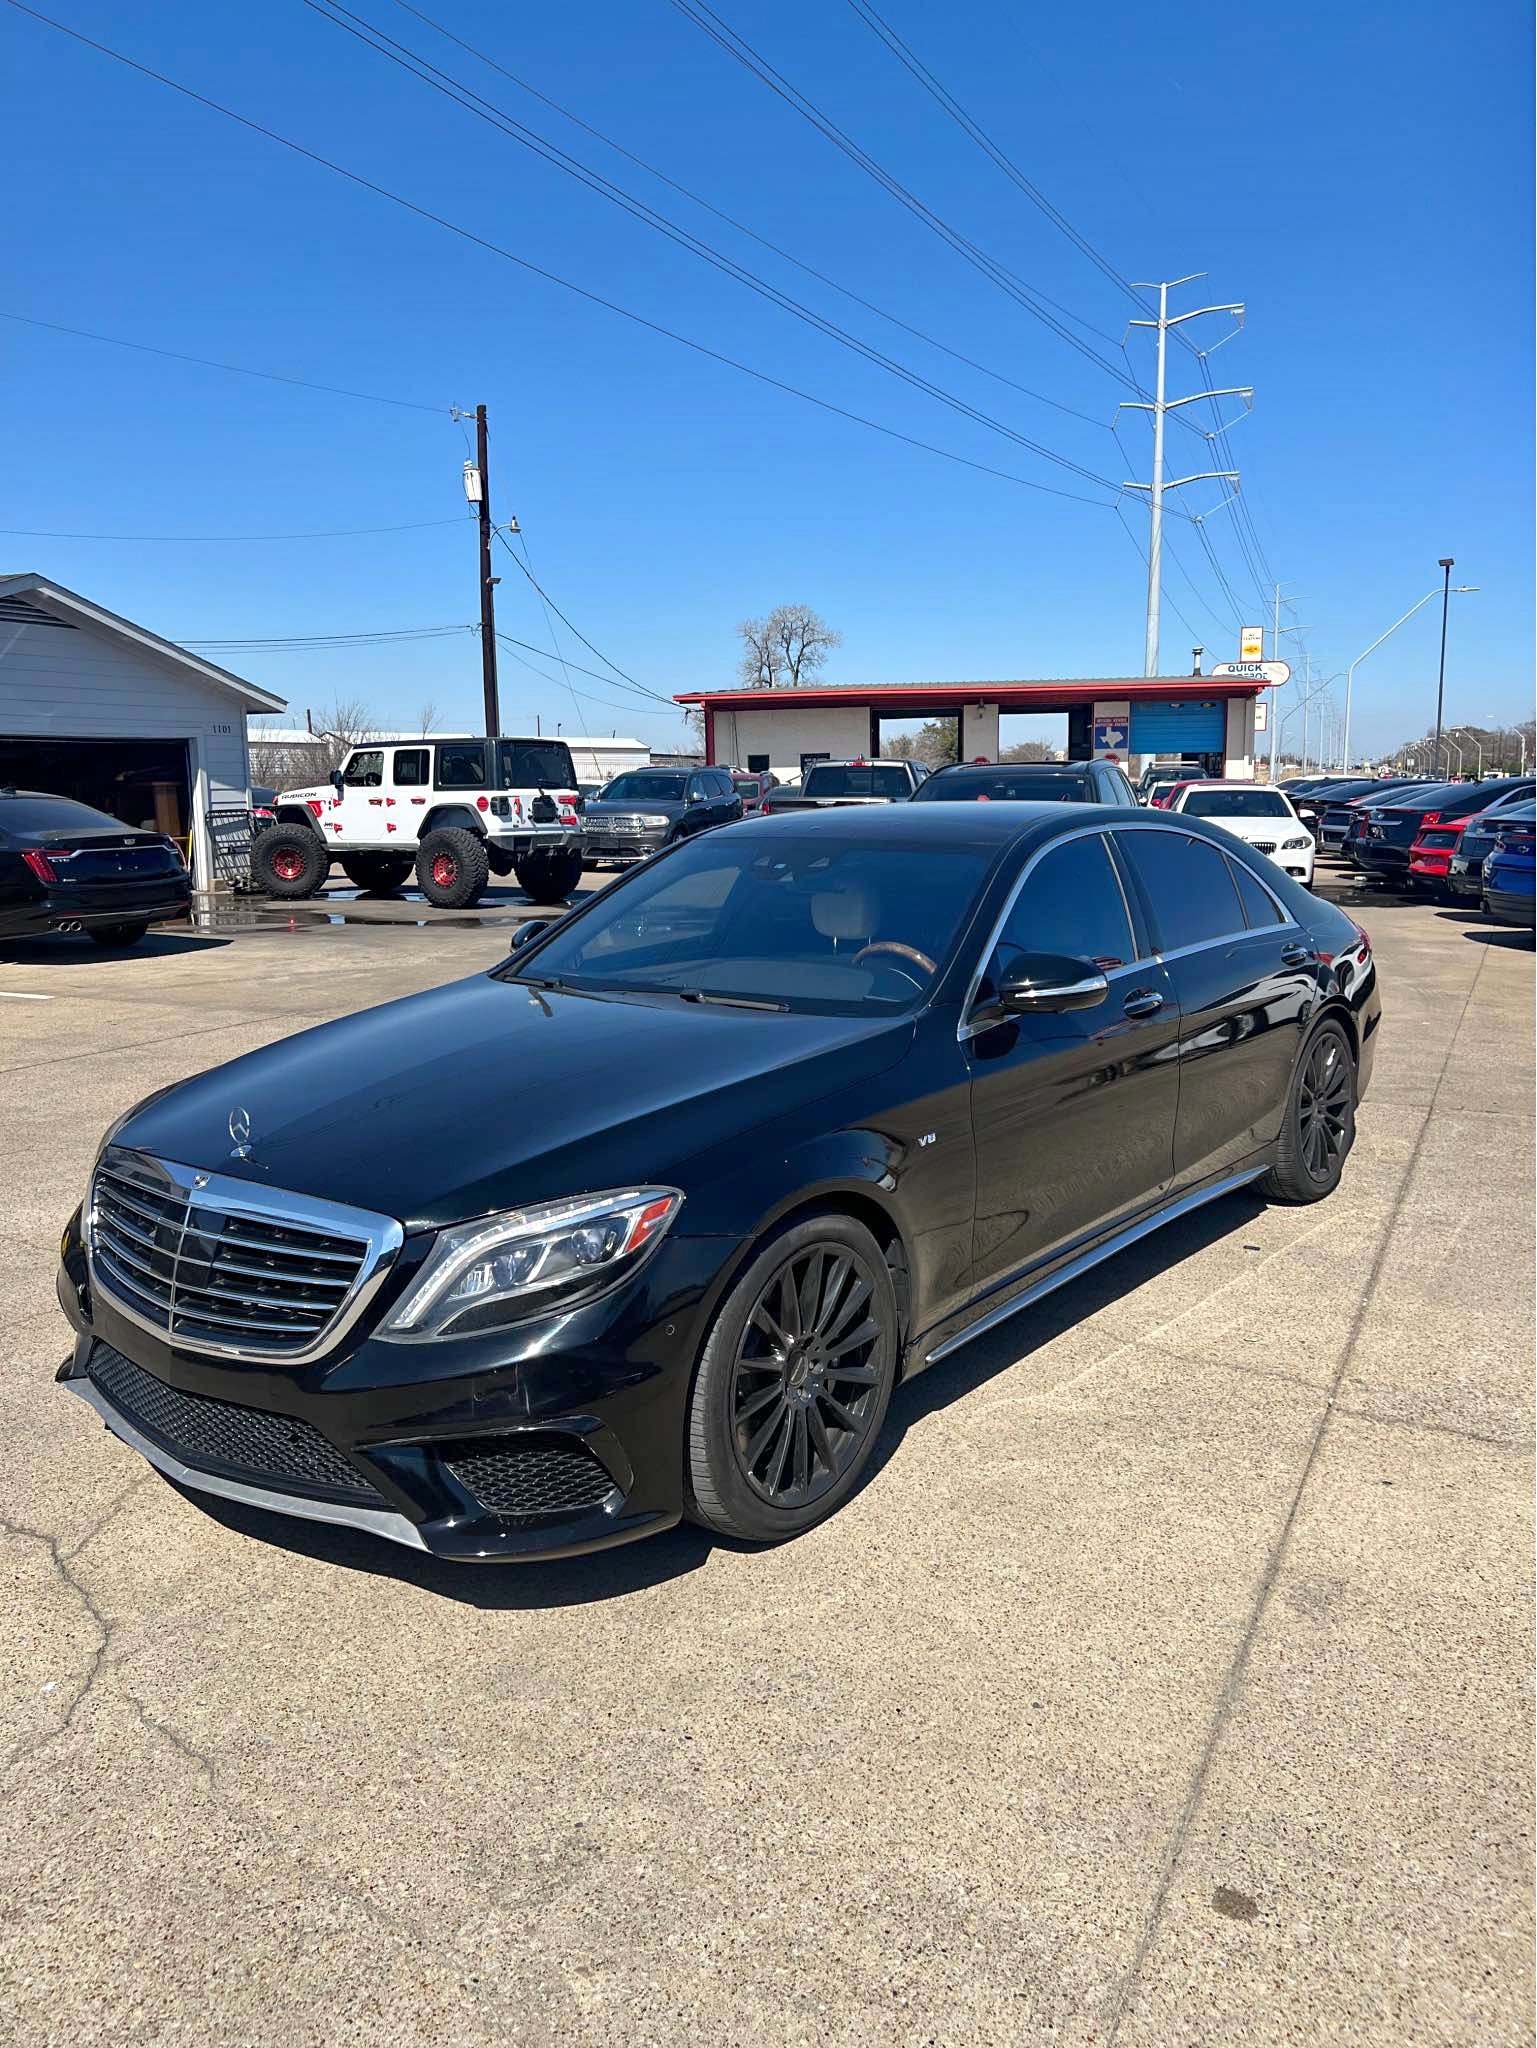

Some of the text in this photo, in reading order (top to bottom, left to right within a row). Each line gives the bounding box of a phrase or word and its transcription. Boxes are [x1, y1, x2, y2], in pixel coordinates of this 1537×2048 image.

[1228, 664, 1262, 672] QUICK
[213, 724, 231, 734] 1101
[281, 791, 317, 800] RUBICON
[918, 1132, 936, 1147] V8
